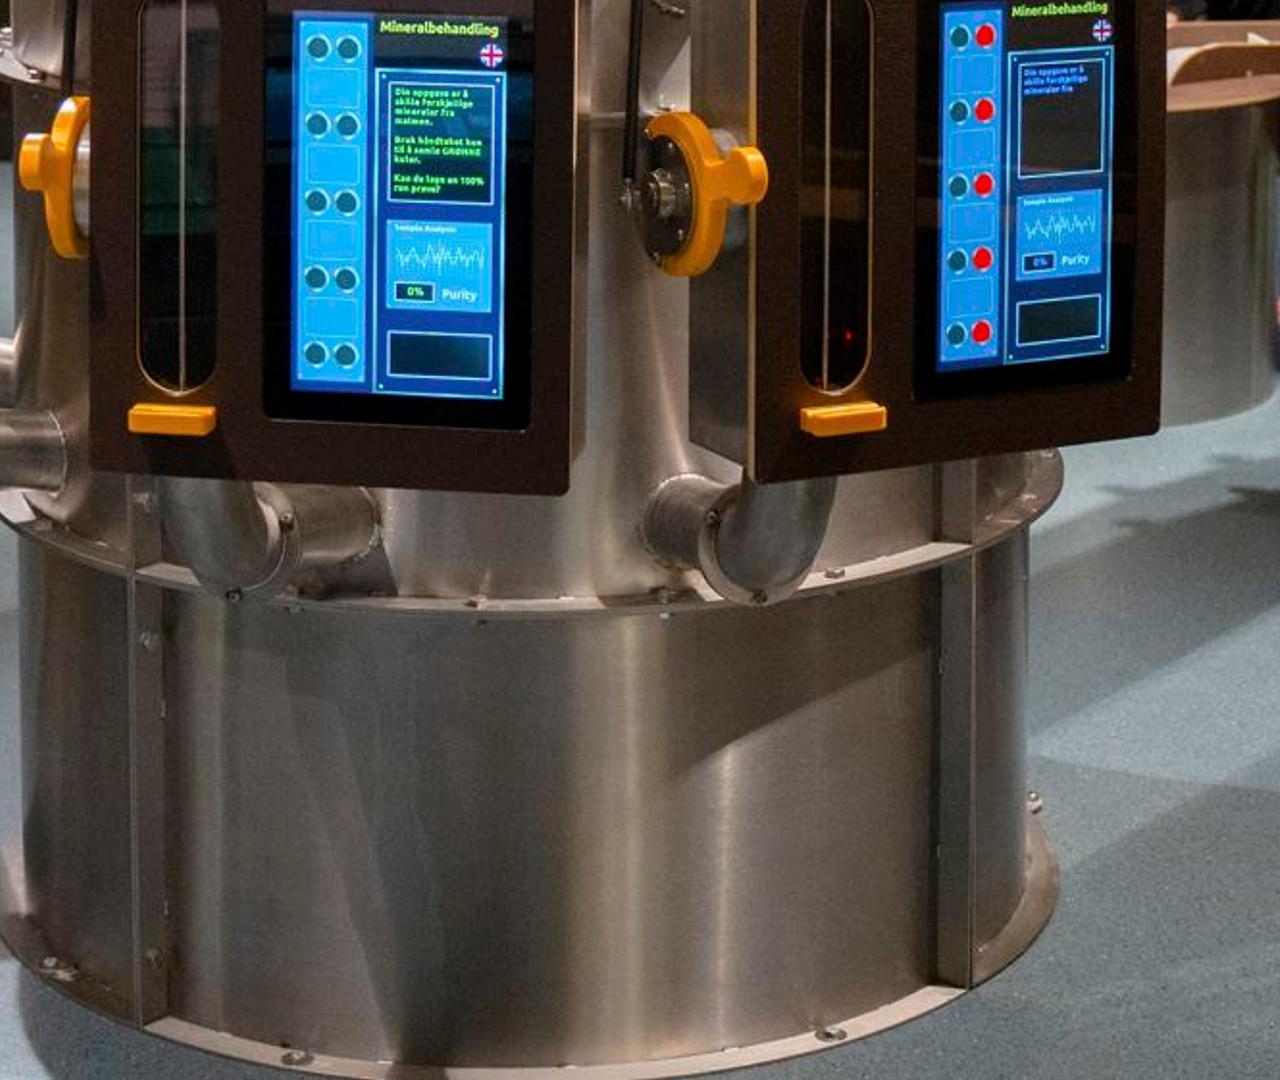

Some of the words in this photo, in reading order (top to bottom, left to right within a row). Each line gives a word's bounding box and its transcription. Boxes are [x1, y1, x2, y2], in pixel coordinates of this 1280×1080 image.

[1011, 0, 1108, 18] Mineralbehandling
[380, 20, 500, 39] Mineralbehandling
[460, 176, 485, 187] 100%
[406, 286, 425, 297] 0%
[442, 288, 478, 303] Purity
